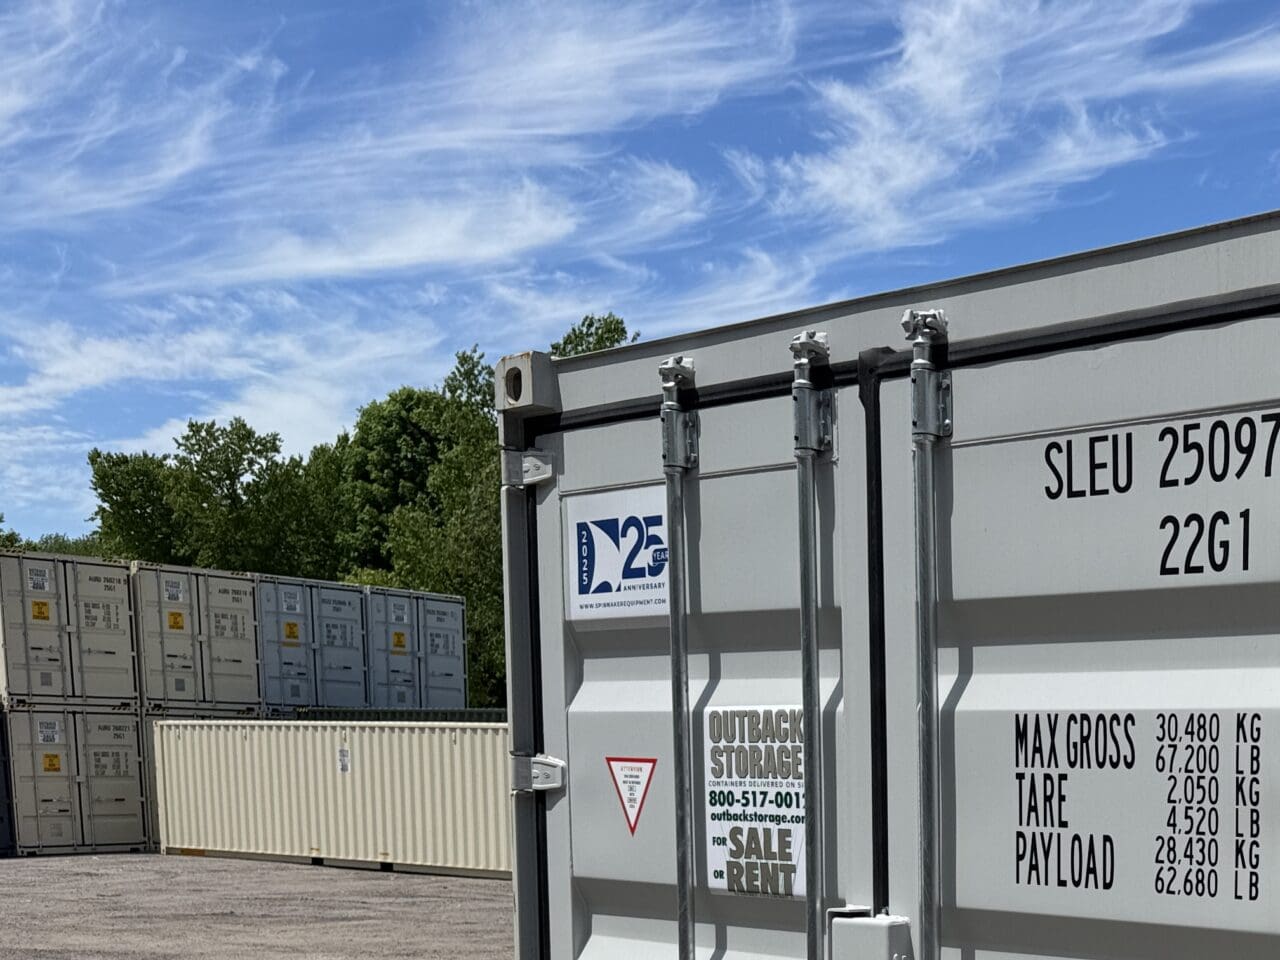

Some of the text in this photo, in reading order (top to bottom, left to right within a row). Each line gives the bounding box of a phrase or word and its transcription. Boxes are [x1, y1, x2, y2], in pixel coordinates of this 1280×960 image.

[1044, 431, 1133, 500] SLEU
[620, 515, 666, 579] 25
[1159, 508, 1250, 576] 22G1
[623, 583, 666, 591] ANNIVERSARY
[708, 709, 804, 744] OUTBACK
[1015, 713, 1261, 770] MAX GROSS 30,480 KG
[710, 744, 803, 780] STORAGE
[1155, 743, 1260, 775] 67,200 LB
[708, 780, 747, 788] CONTAINERS
[1015, 773, 1260, 828] TARE 2,050 KG
[1166, 805, 1260, 838] 4,520 LB
[712, 826, 792, 861] FOR SALE
[713, 861, 796, 896] OR RENT
[1015, 833, 1260, 890] PAYLOAD 28,430 KG
[1154, 866, 1259, 901] 62,680 LB
